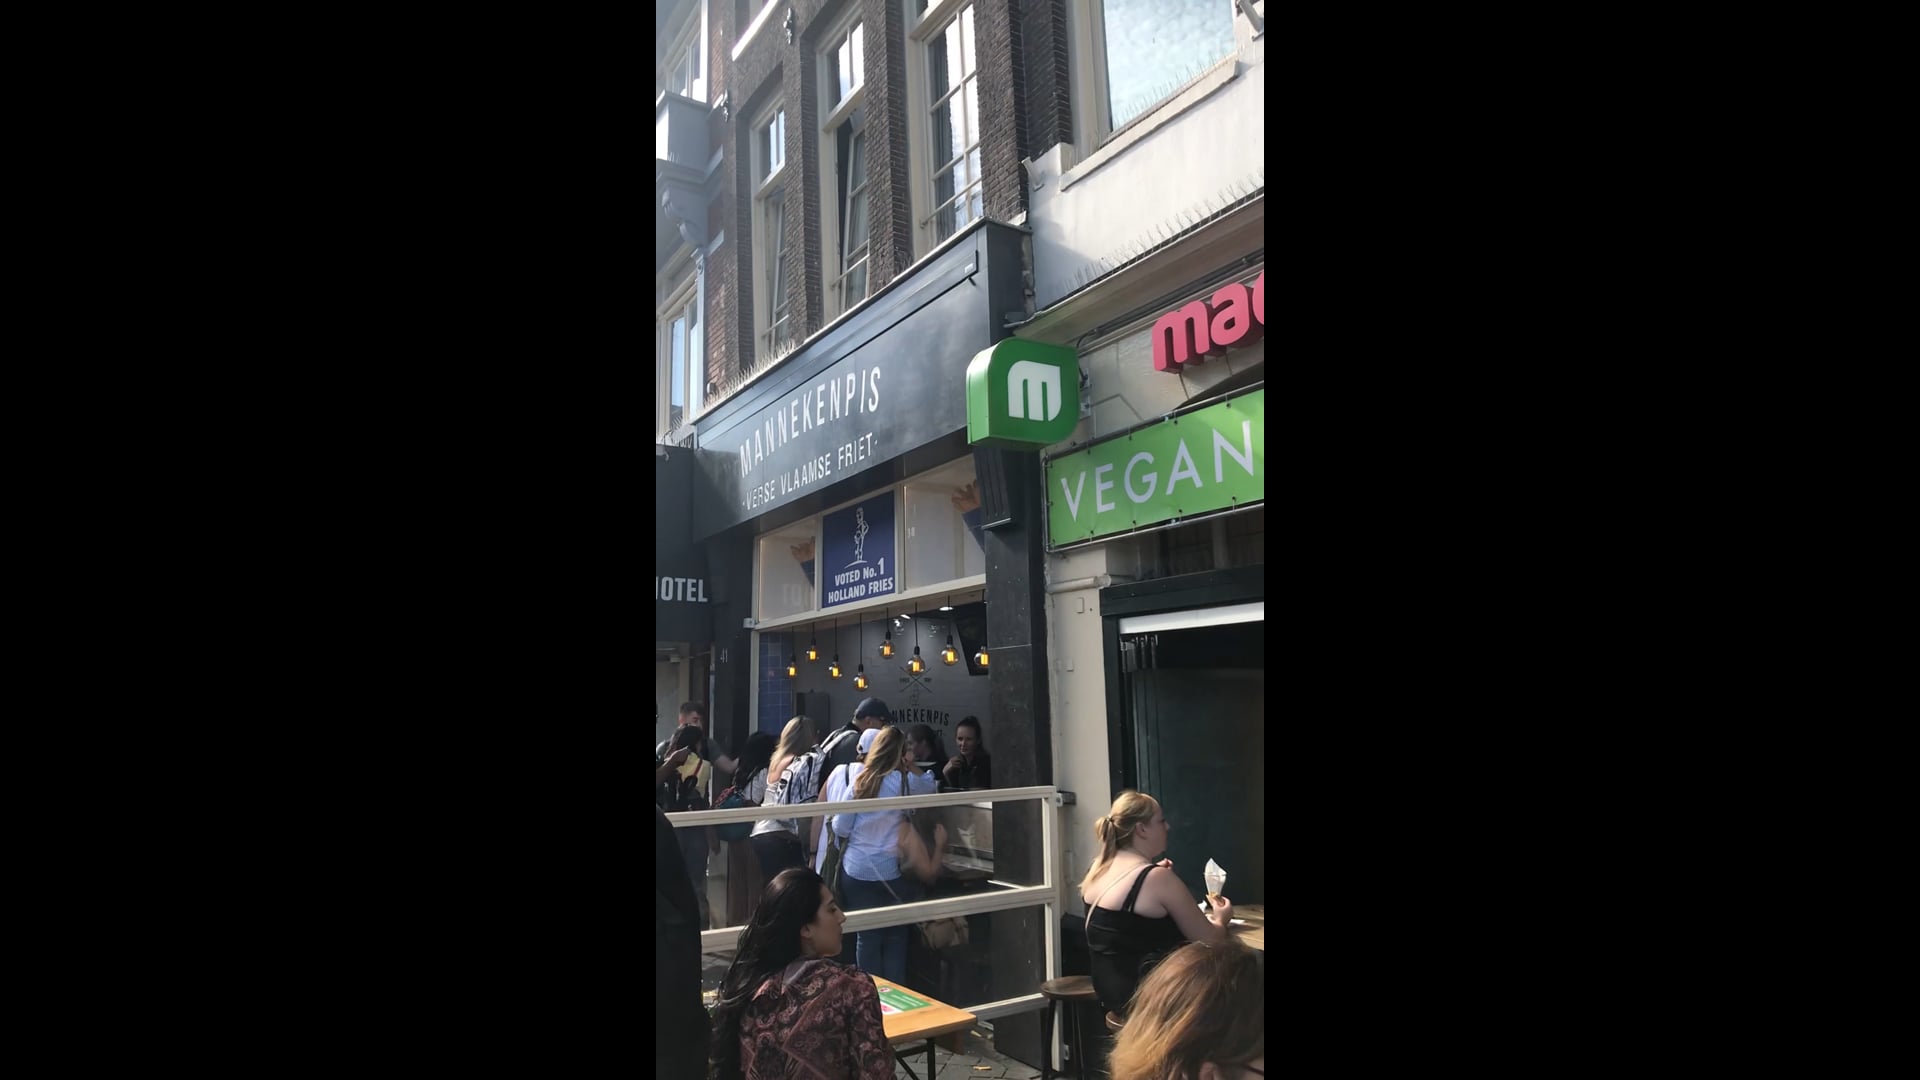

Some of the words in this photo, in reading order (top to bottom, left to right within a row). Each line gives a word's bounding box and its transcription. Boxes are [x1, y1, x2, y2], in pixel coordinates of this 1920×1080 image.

[739, 366, 881, 479] MANNEKENPIS
[780, 452, 831, 495] VLAAMSE
[1060, 419, 1254, 522] VEGAN
[656, 576, 708, 603] OTEL
[828, 585, 866, 604] HOLLAND
[868, 577, 894, 595] FRIES
[834, 569, 860, 587] VOTED
[891, 708, 950, 727] NNEKENPIS
